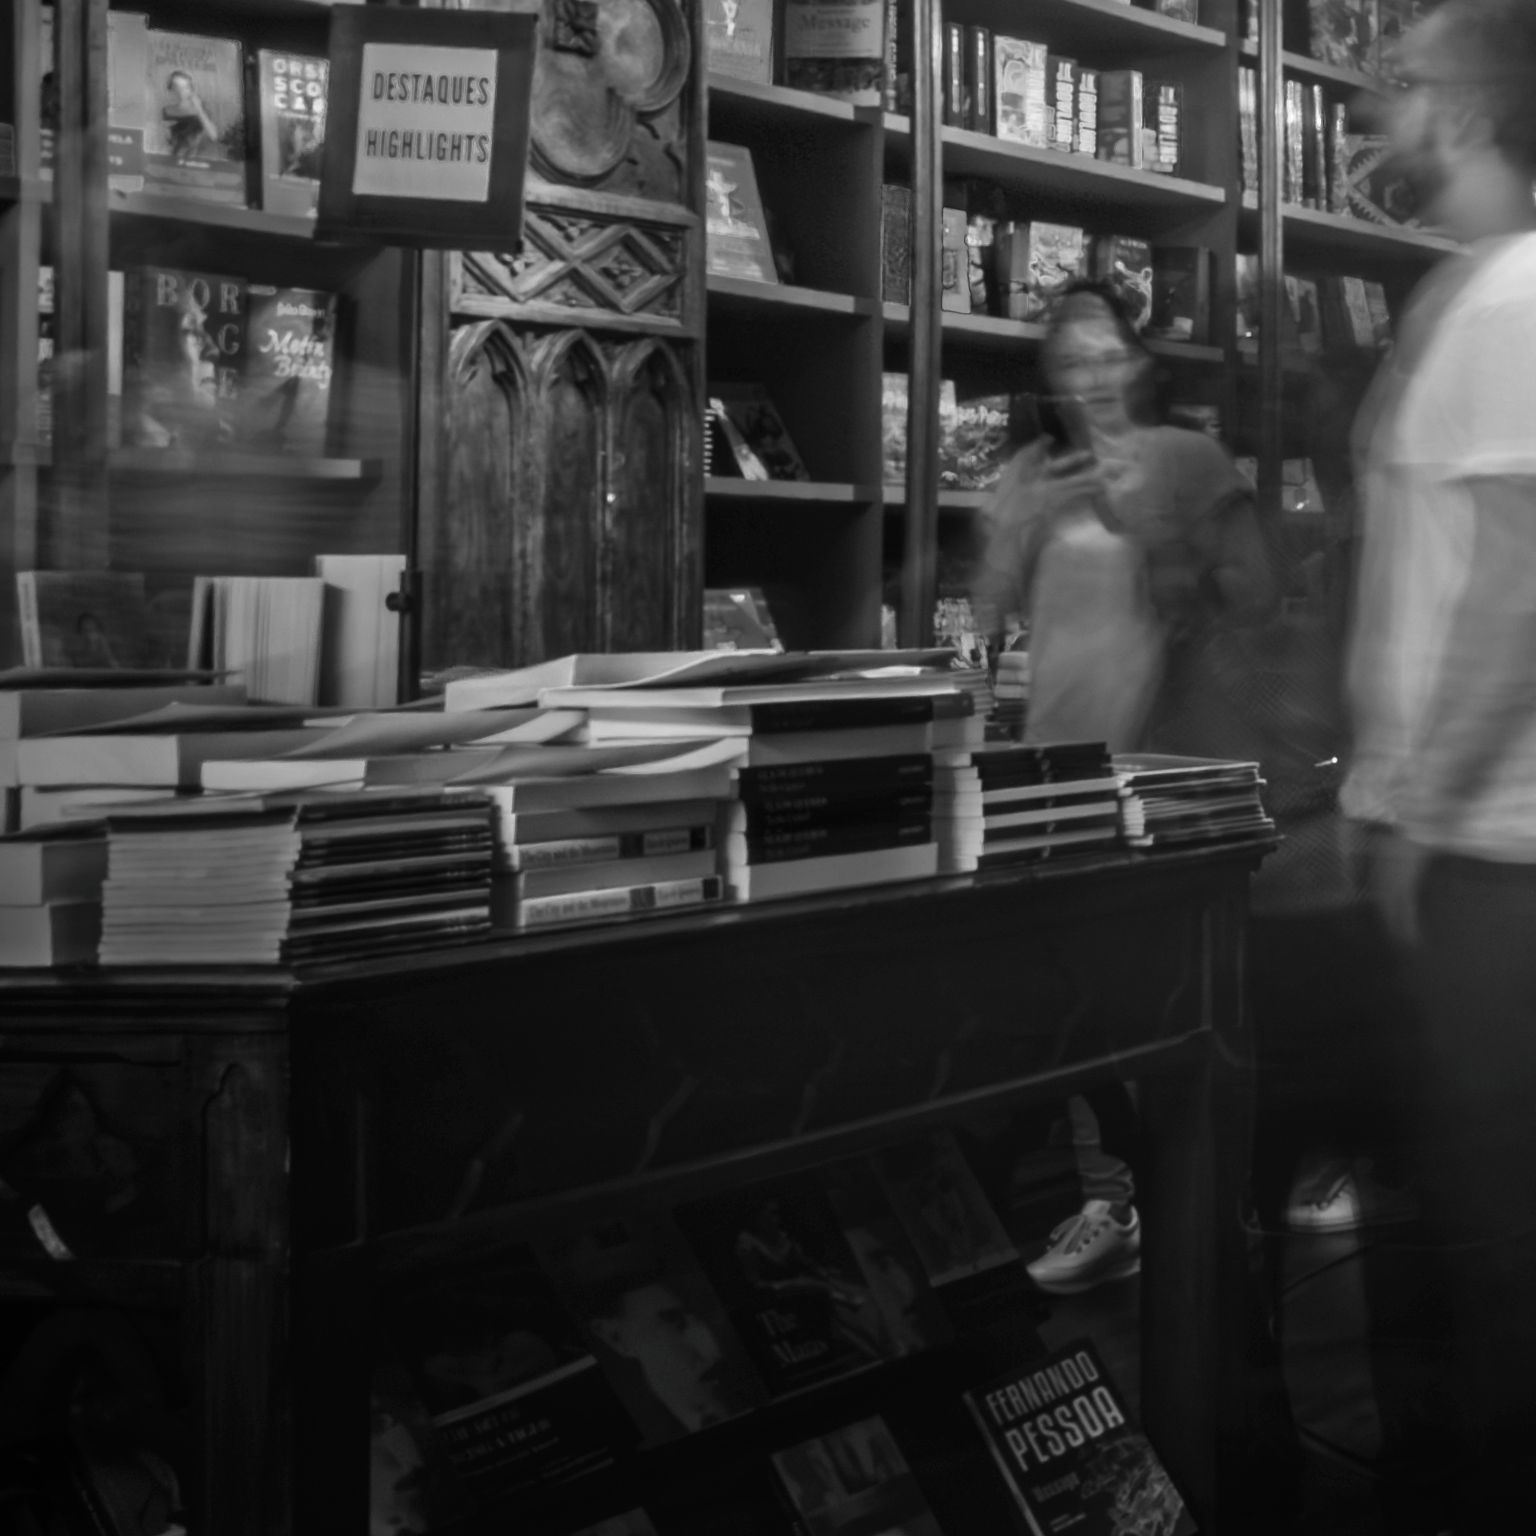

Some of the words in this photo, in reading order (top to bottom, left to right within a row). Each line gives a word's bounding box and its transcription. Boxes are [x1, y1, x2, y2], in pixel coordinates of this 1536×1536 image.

[371, 70, 490, 106] DESTAQUES
[365, 129, 490, 164] HIGHLIGHTS
[986, 1351, 1099, 1425] FERNANDO
[1005, 1385, 1125, 1472] PESSOA
